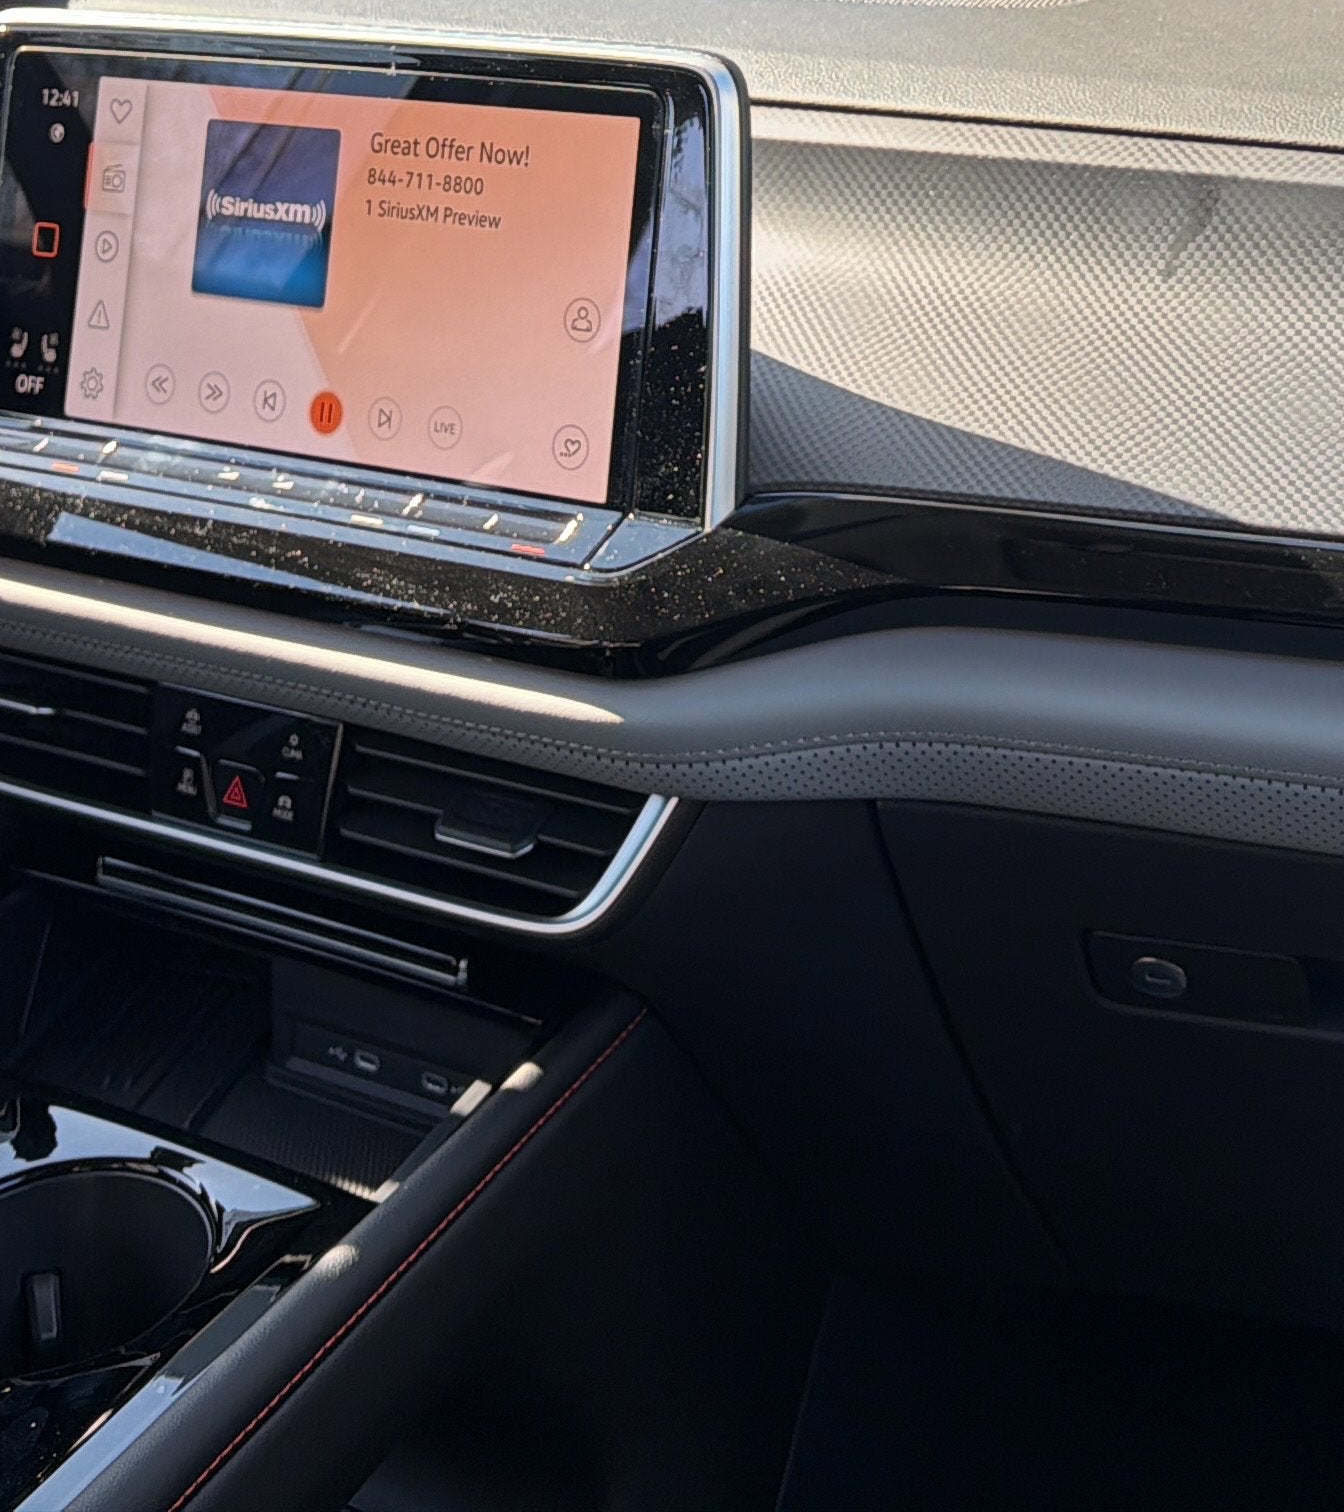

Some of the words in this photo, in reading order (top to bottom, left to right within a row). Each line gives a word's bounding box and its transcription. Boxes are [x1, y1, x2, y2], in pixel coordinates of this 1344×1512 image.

[42, 87, 80, 108] 12:41
[369, 131, 421, 159] Great
[425, 136, 476, 163] Offer
[478, 140, 531, 168] Now!
[367, 167, 485, 196] 844-711-8800
[365, 198, 373, 217] 1
[377, 199, 440, 224] SiriusXM
[443, 206, 503, 230] Preview
[15, 373, 46, 395] OFF
[433, 421, 456, 436] LIVE
